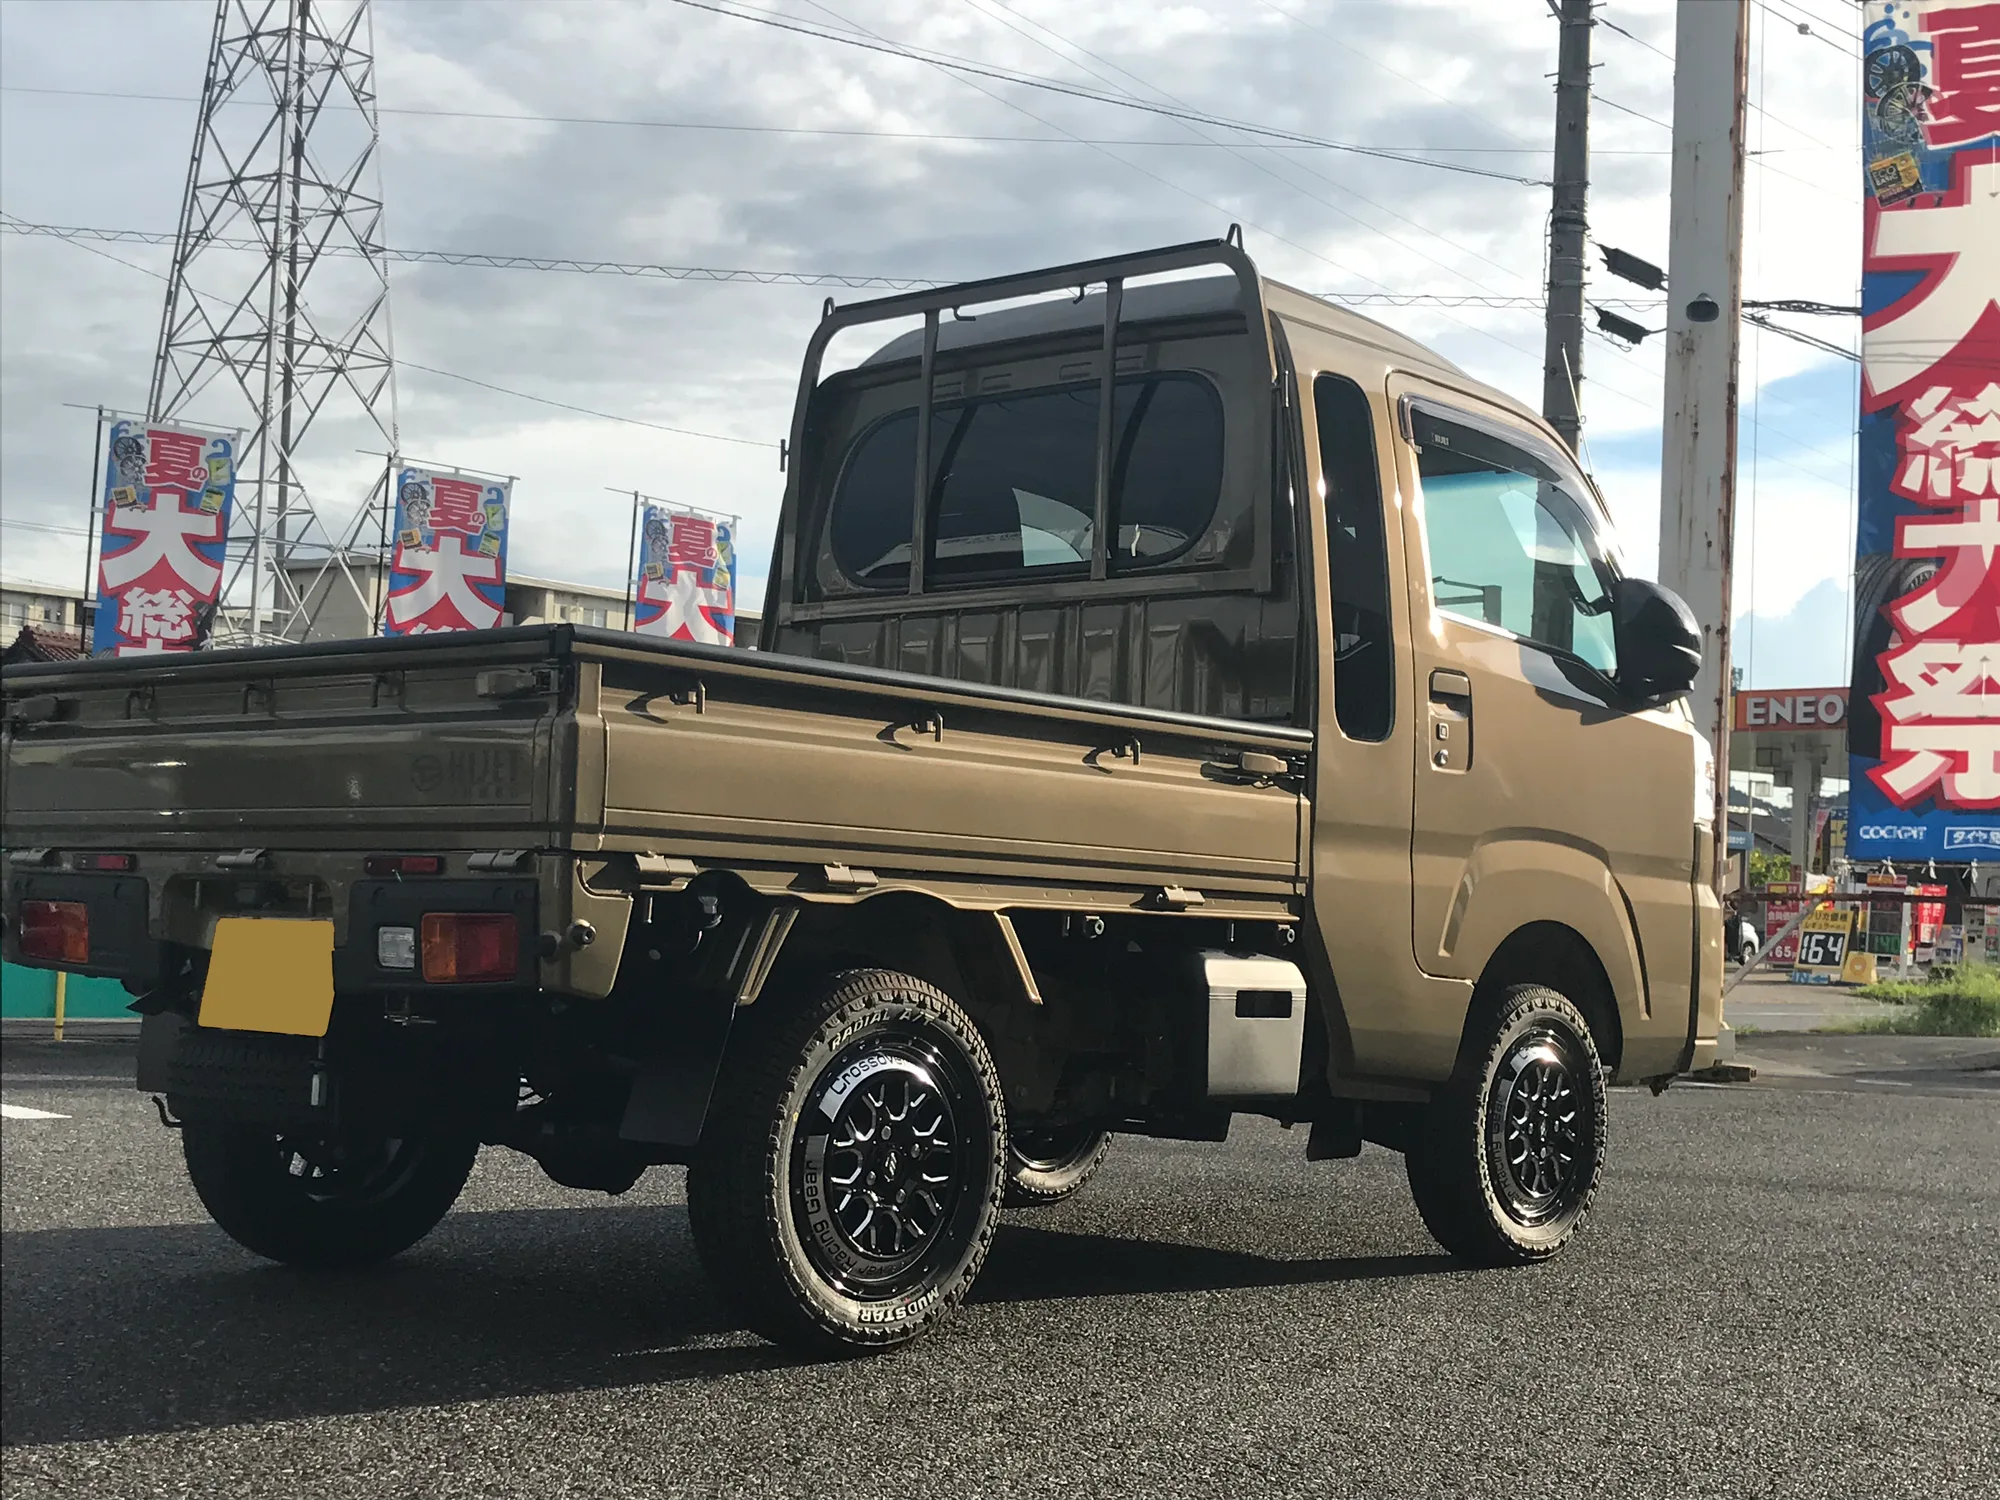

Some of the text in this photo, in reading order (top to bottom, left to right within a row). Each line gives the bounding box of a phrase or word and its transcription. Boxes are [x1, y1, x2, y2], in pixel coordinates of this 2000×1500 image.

[1746, 694, 1848, 725] ENEO
[1859, 825, 1927, 840] COCKPIT
[1800, 934, 1843, 964] 164
[831, 1008, 935, 1050] RADIAL A/T
[805, 1160, 857, 1273] Racing Gear
[859, 1284, 939, 1322] MUDSTAR
